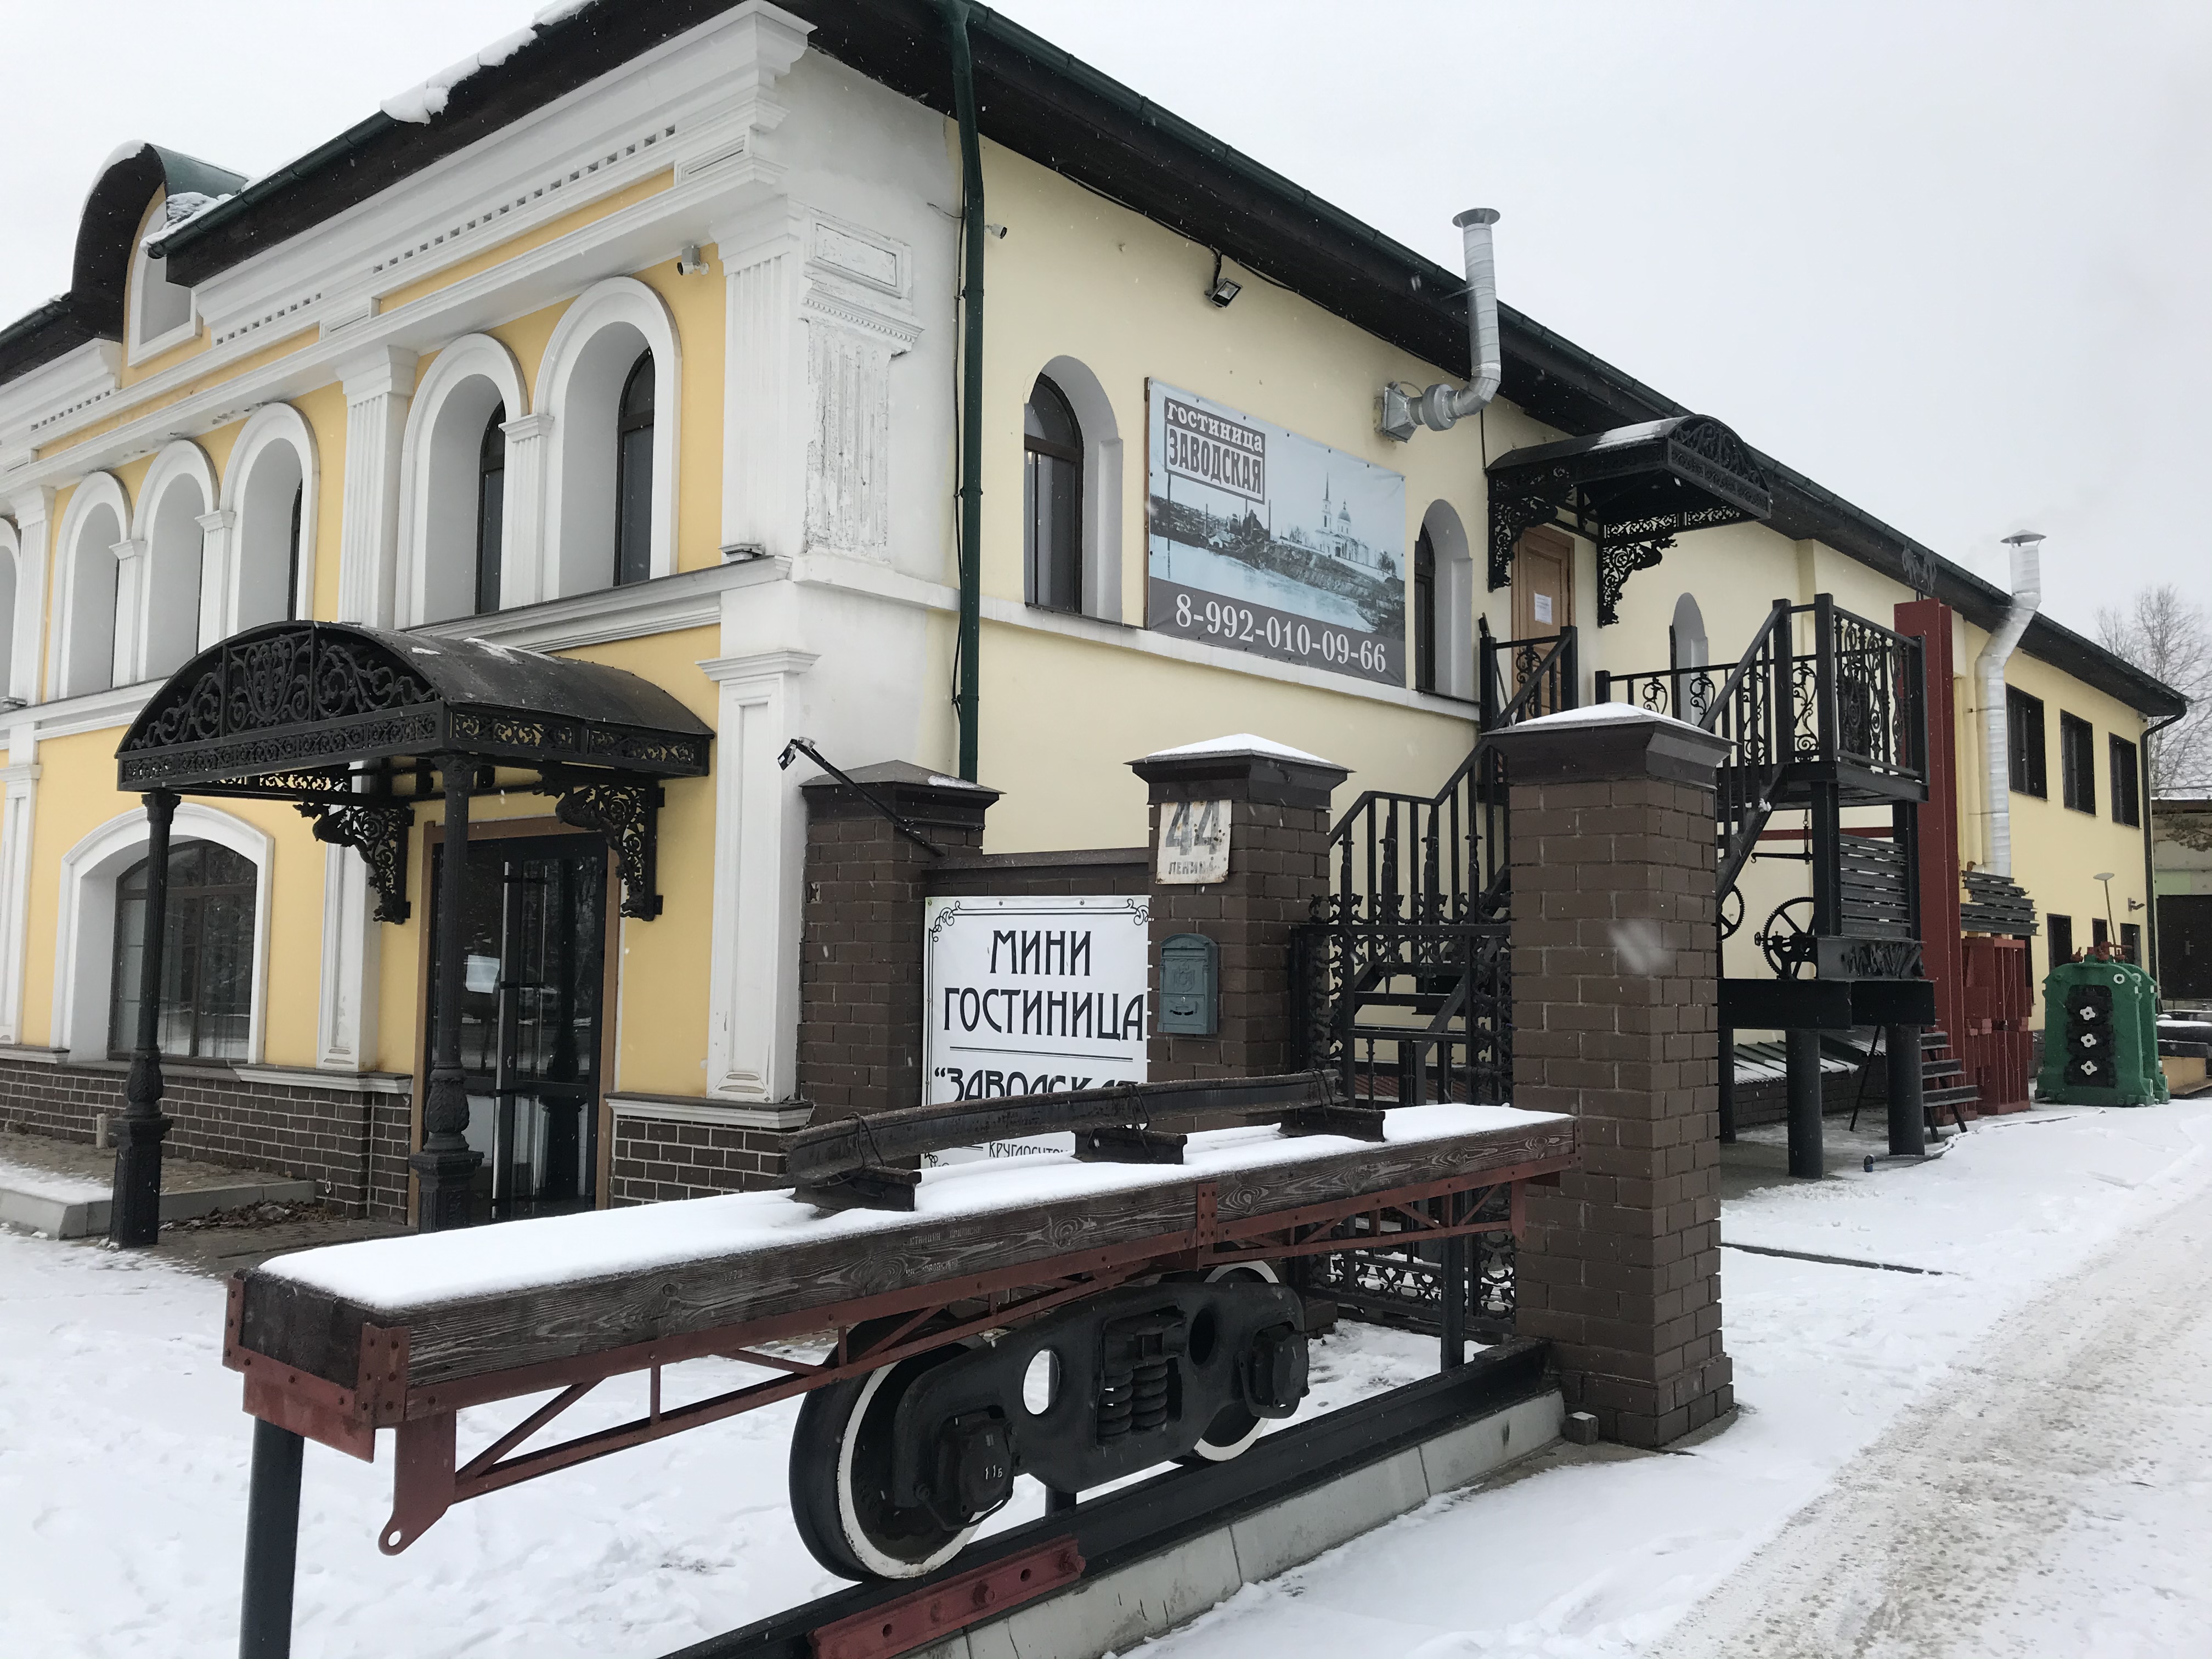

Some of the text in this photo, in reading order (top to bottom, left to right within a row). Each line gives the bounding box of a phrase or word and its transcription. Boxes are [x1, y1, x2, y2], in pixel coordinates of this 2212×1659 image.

[1169, 428, 1261, 494] ЗАВОДСКАЯ
[1176, 593, 1386, 673] 8-992-010-09-66
[1165, 802, 1222, 856] 44
[989, 930, 1091, 977] МИНИ
[944, 987, 1144, 1042] ГОСТИНИЦА
